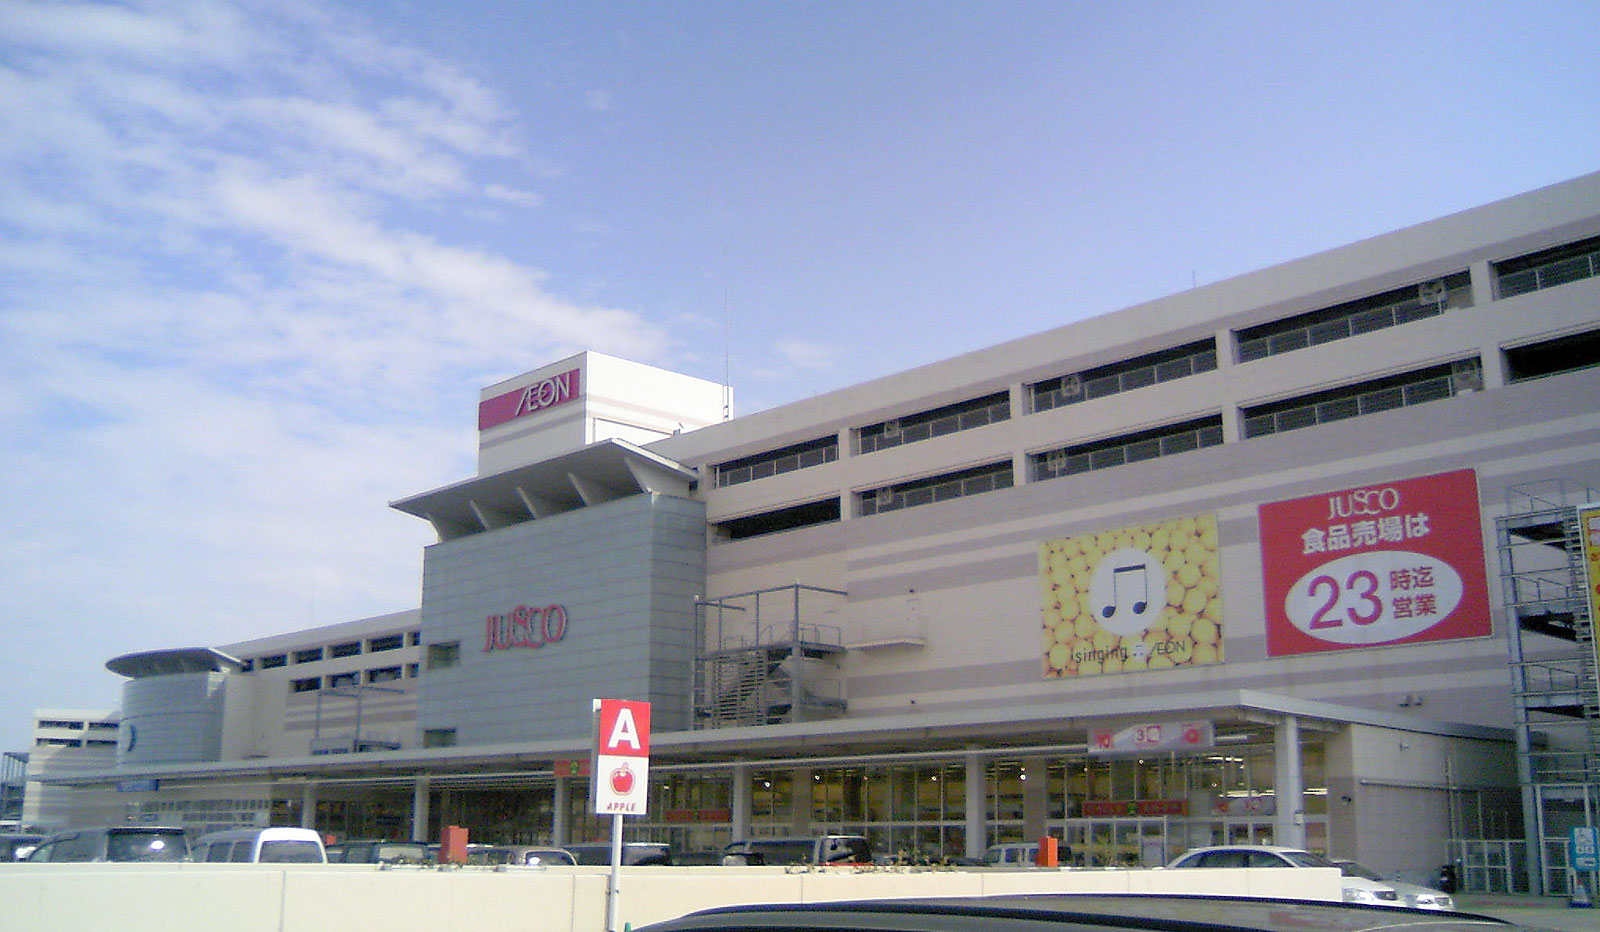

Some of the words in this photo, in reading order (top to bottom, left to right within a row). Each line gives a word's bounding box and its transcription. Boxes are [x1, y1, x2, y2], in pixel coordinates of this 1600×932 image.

[1328, 488, 1400, 520] JUSCO
[1302, 513, 1430, 554] 食品売場は
[1307, 569, 1382, 630] 23
[481, 603, 569, 652] JUSCO
[608, 707, 641, 749] A
[606, 802, 637, 812] APPLE
